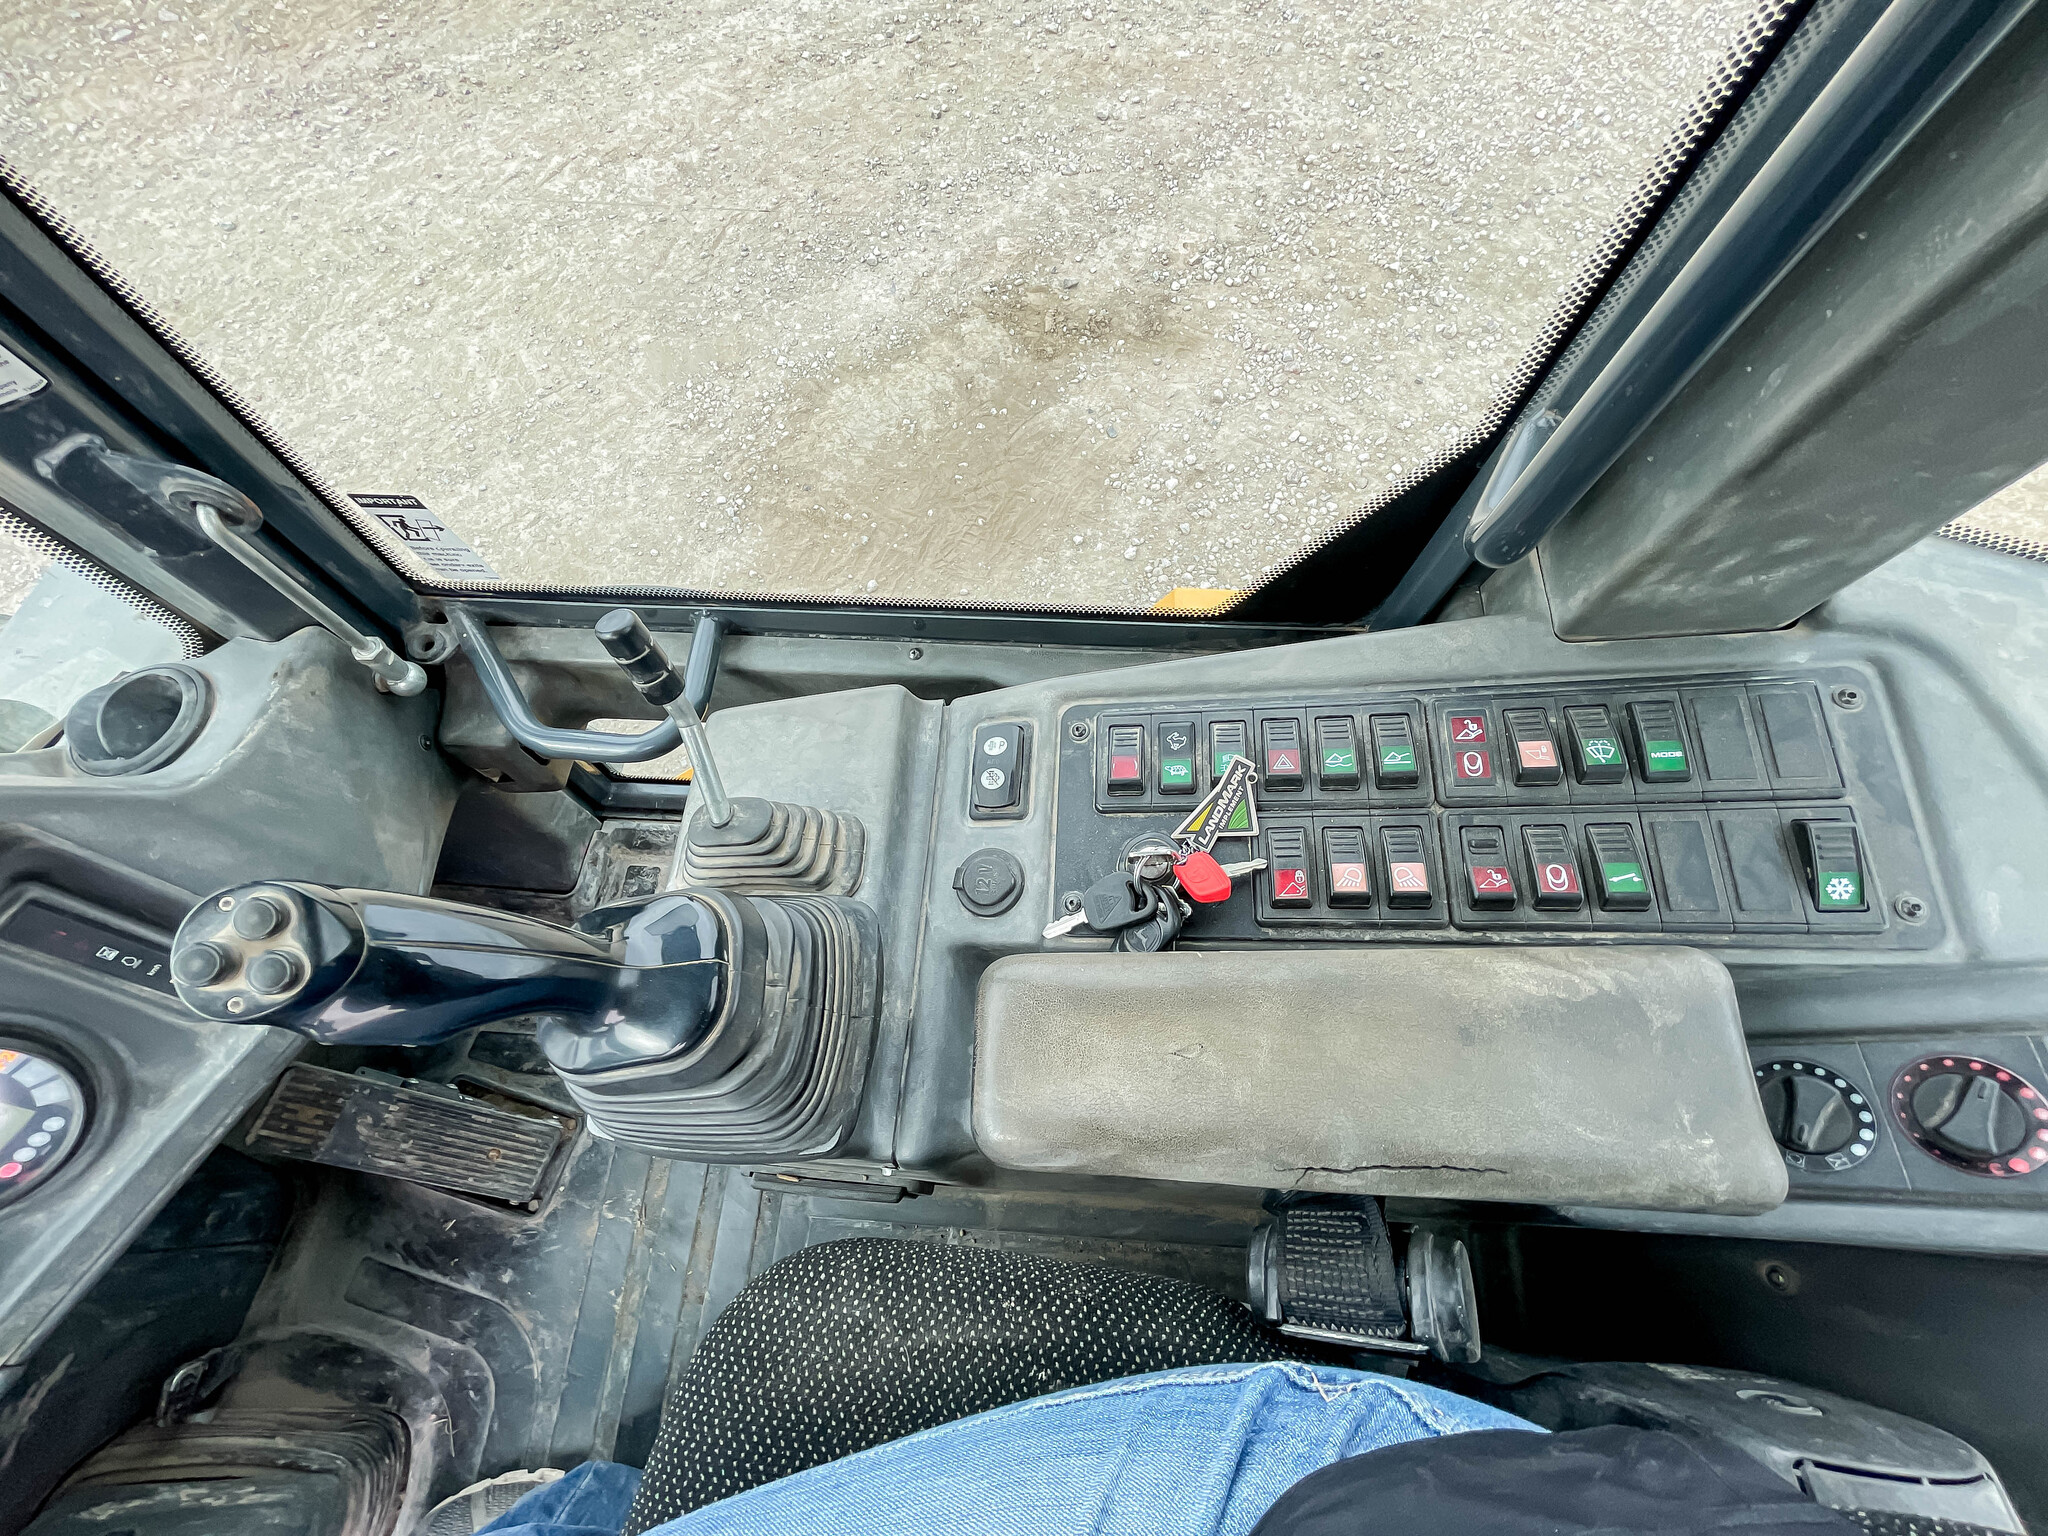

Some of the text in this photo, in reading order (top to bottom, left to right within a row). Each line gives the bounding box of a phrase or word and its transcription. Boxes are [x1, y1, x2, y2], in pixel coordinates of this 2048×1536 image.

[353, 496, 418, 506] IMPORTANT
[1650, 751, 1684, 759] MODE
[1198, 764, 1247, 845] LANDMARK
[1218, 785, 1245, 830] IMPLEMENT
